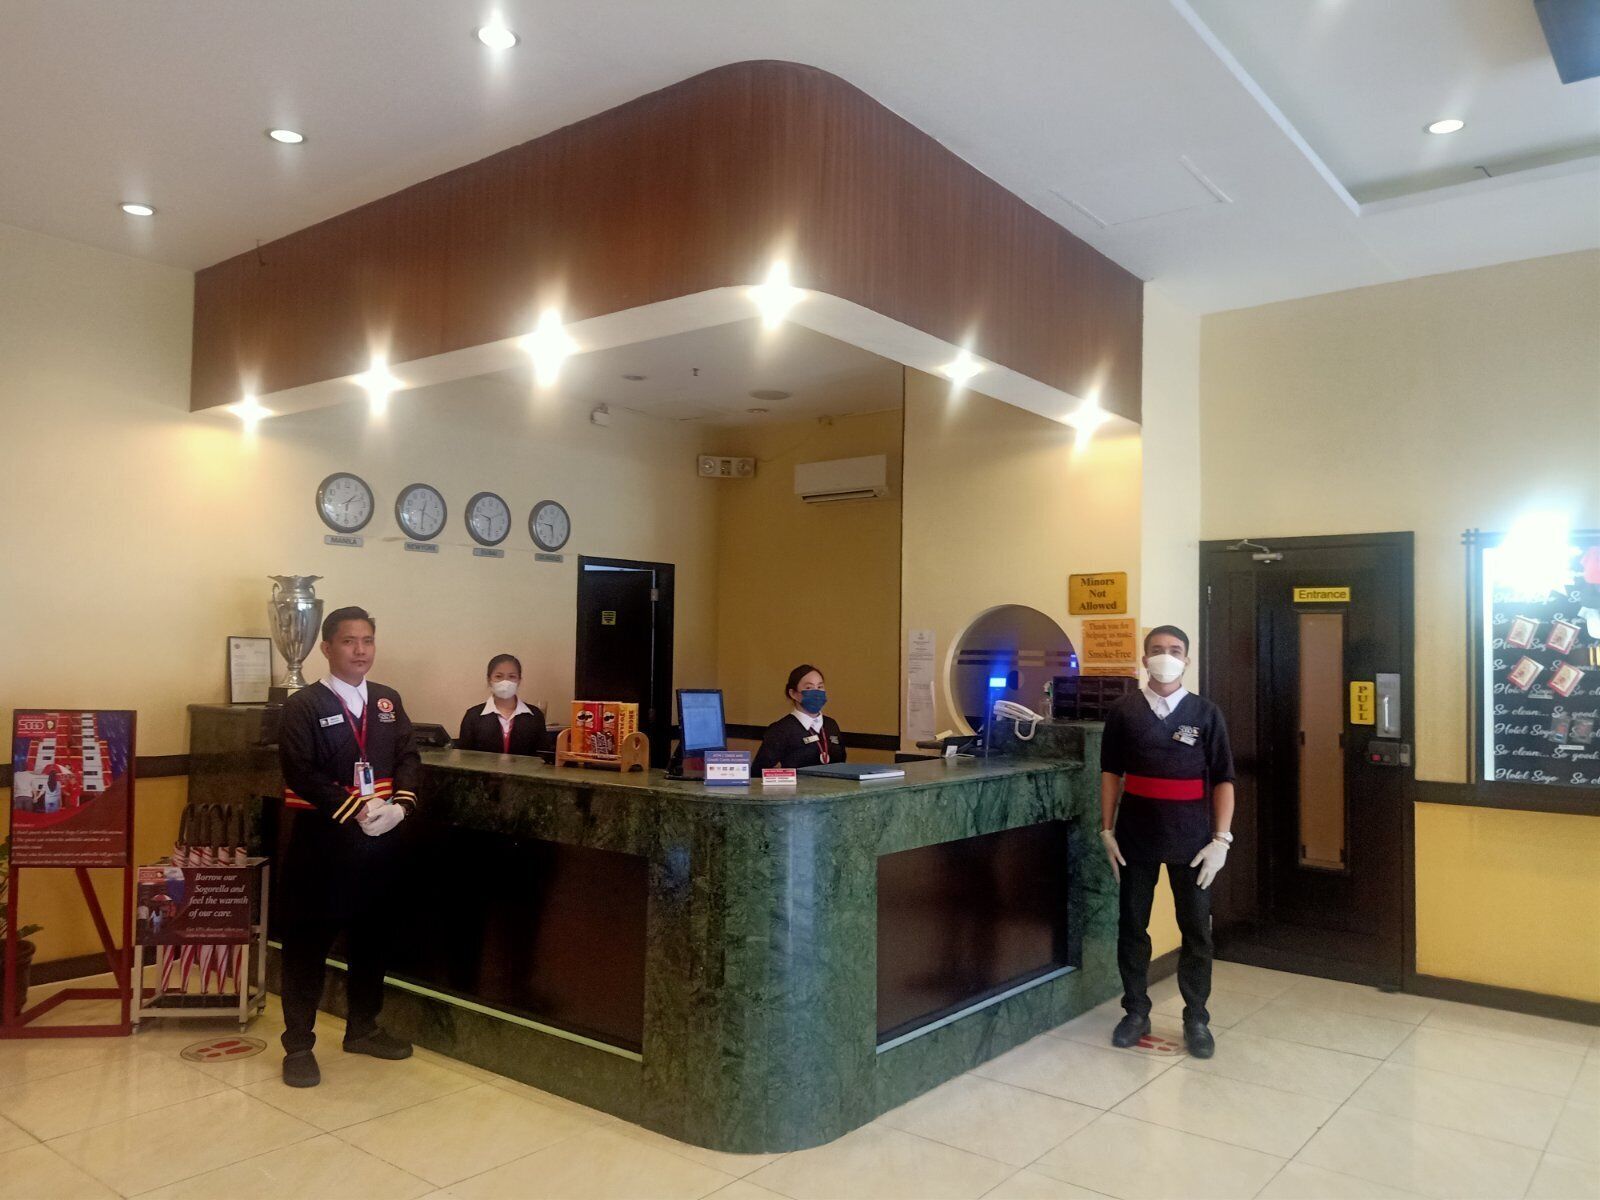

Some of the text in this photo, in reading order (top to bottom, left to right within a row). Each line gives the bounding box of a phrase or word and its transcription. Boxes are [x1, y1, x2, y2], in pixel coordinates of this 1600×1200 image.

[1080, 578, 1115, 586] Minors
[1089, 590, 1106, 598] Not
[1299, 590, 1346, 600] Entrance
[1080, 602, 1117, 610] Allowed
[1088, 650, 1132, 658] Smoke-Free
[1494, 658, 1507, 670] So
[1358, 686, 1368, 720] PULL
[1494, 704, 1508, 716] So
[1552, 706, 1567, 718] So
[1494, 722, 1528, 736] Hotel
[1530, 724, 1556, 738] Sogo
[1494, 744, 1508, 756] So
[1552, 747, 1568, 758] So
[1496, 768, 1530, 780] Hotel
[1532, 770, 1558, 784] Sogo
[1570, 772, 1588, 784] So
[195, 873, 222, 881] Borrow
[194, 884, 246, 894] Sogorella and
[188, 896, 249, 906] feel the warmth
[188, 908, 200, 920] of
